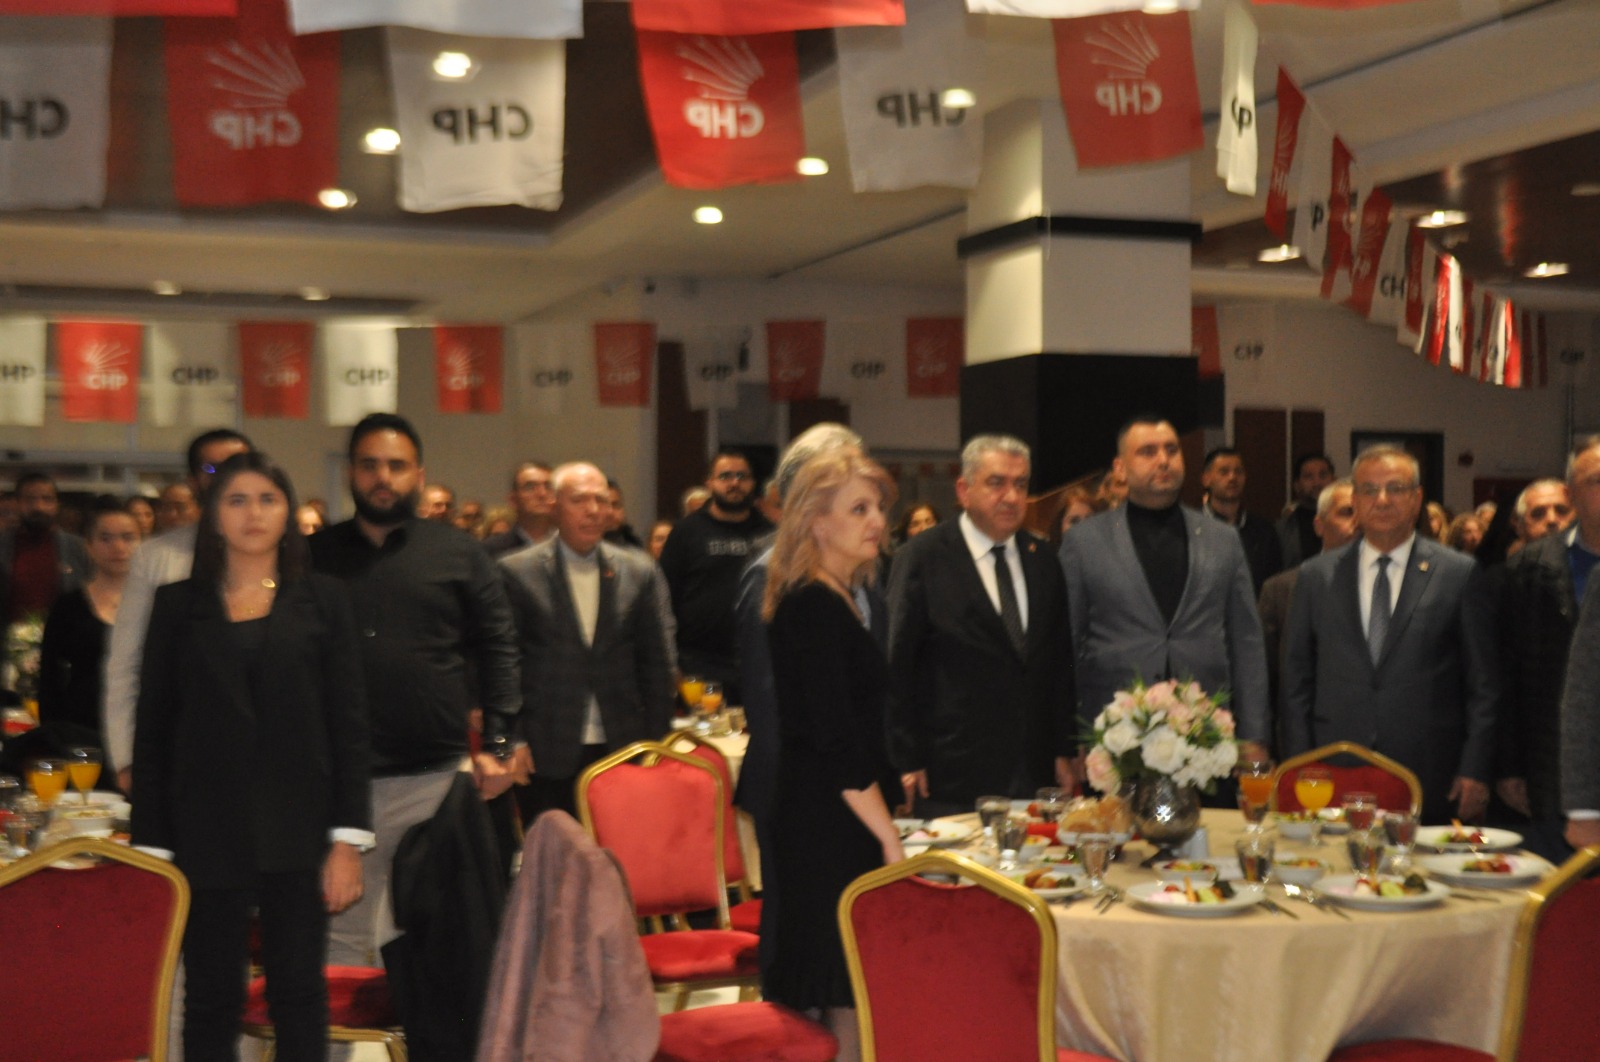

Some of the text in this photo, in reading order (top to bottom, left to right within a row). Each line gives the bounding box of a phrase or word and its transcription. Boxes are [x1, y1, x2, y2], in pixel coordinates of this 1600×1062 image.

[0, 364, 36, 381] HP
[172, 367, 219, 386] CHP
[344, 368, 391, 387] CHP
[533, 369, 573, 387] CHP
[850, 362, 886, 380] CHP
[85, 372, 129, 390] CHP
